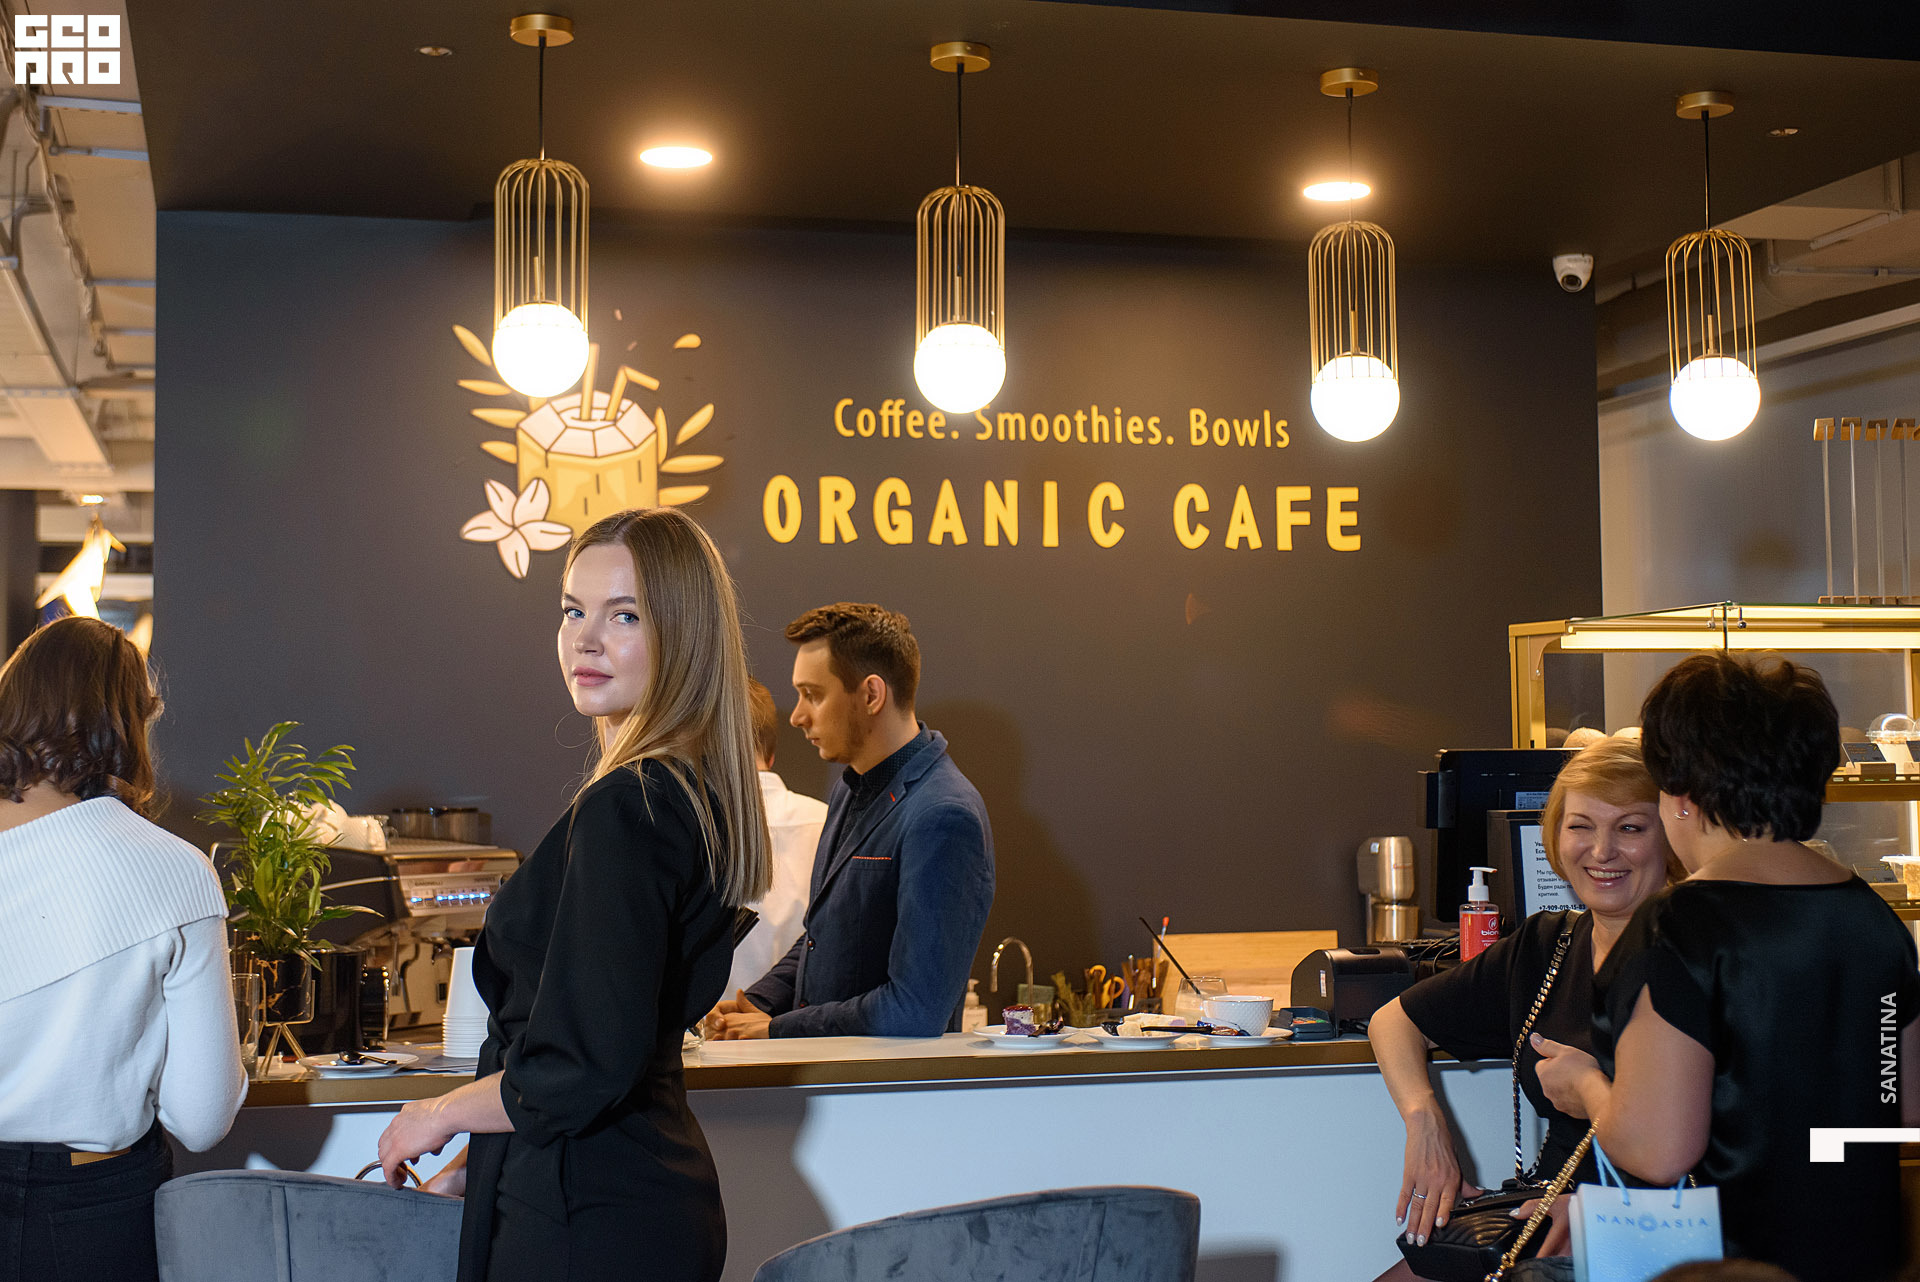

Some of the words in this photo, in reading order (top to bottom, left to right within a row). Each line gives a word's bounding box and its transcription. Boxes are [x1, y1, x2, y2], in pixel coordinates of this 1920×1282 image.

[834, 397, 960, 440] Coffee.
[974, 404, 1175, 447] Smoothies.
[1188, 407, 1290, 449] Bowls
[762, 473, 1126, 550] ORGANIC
[1172, 482, 1362, 552] CAFE
